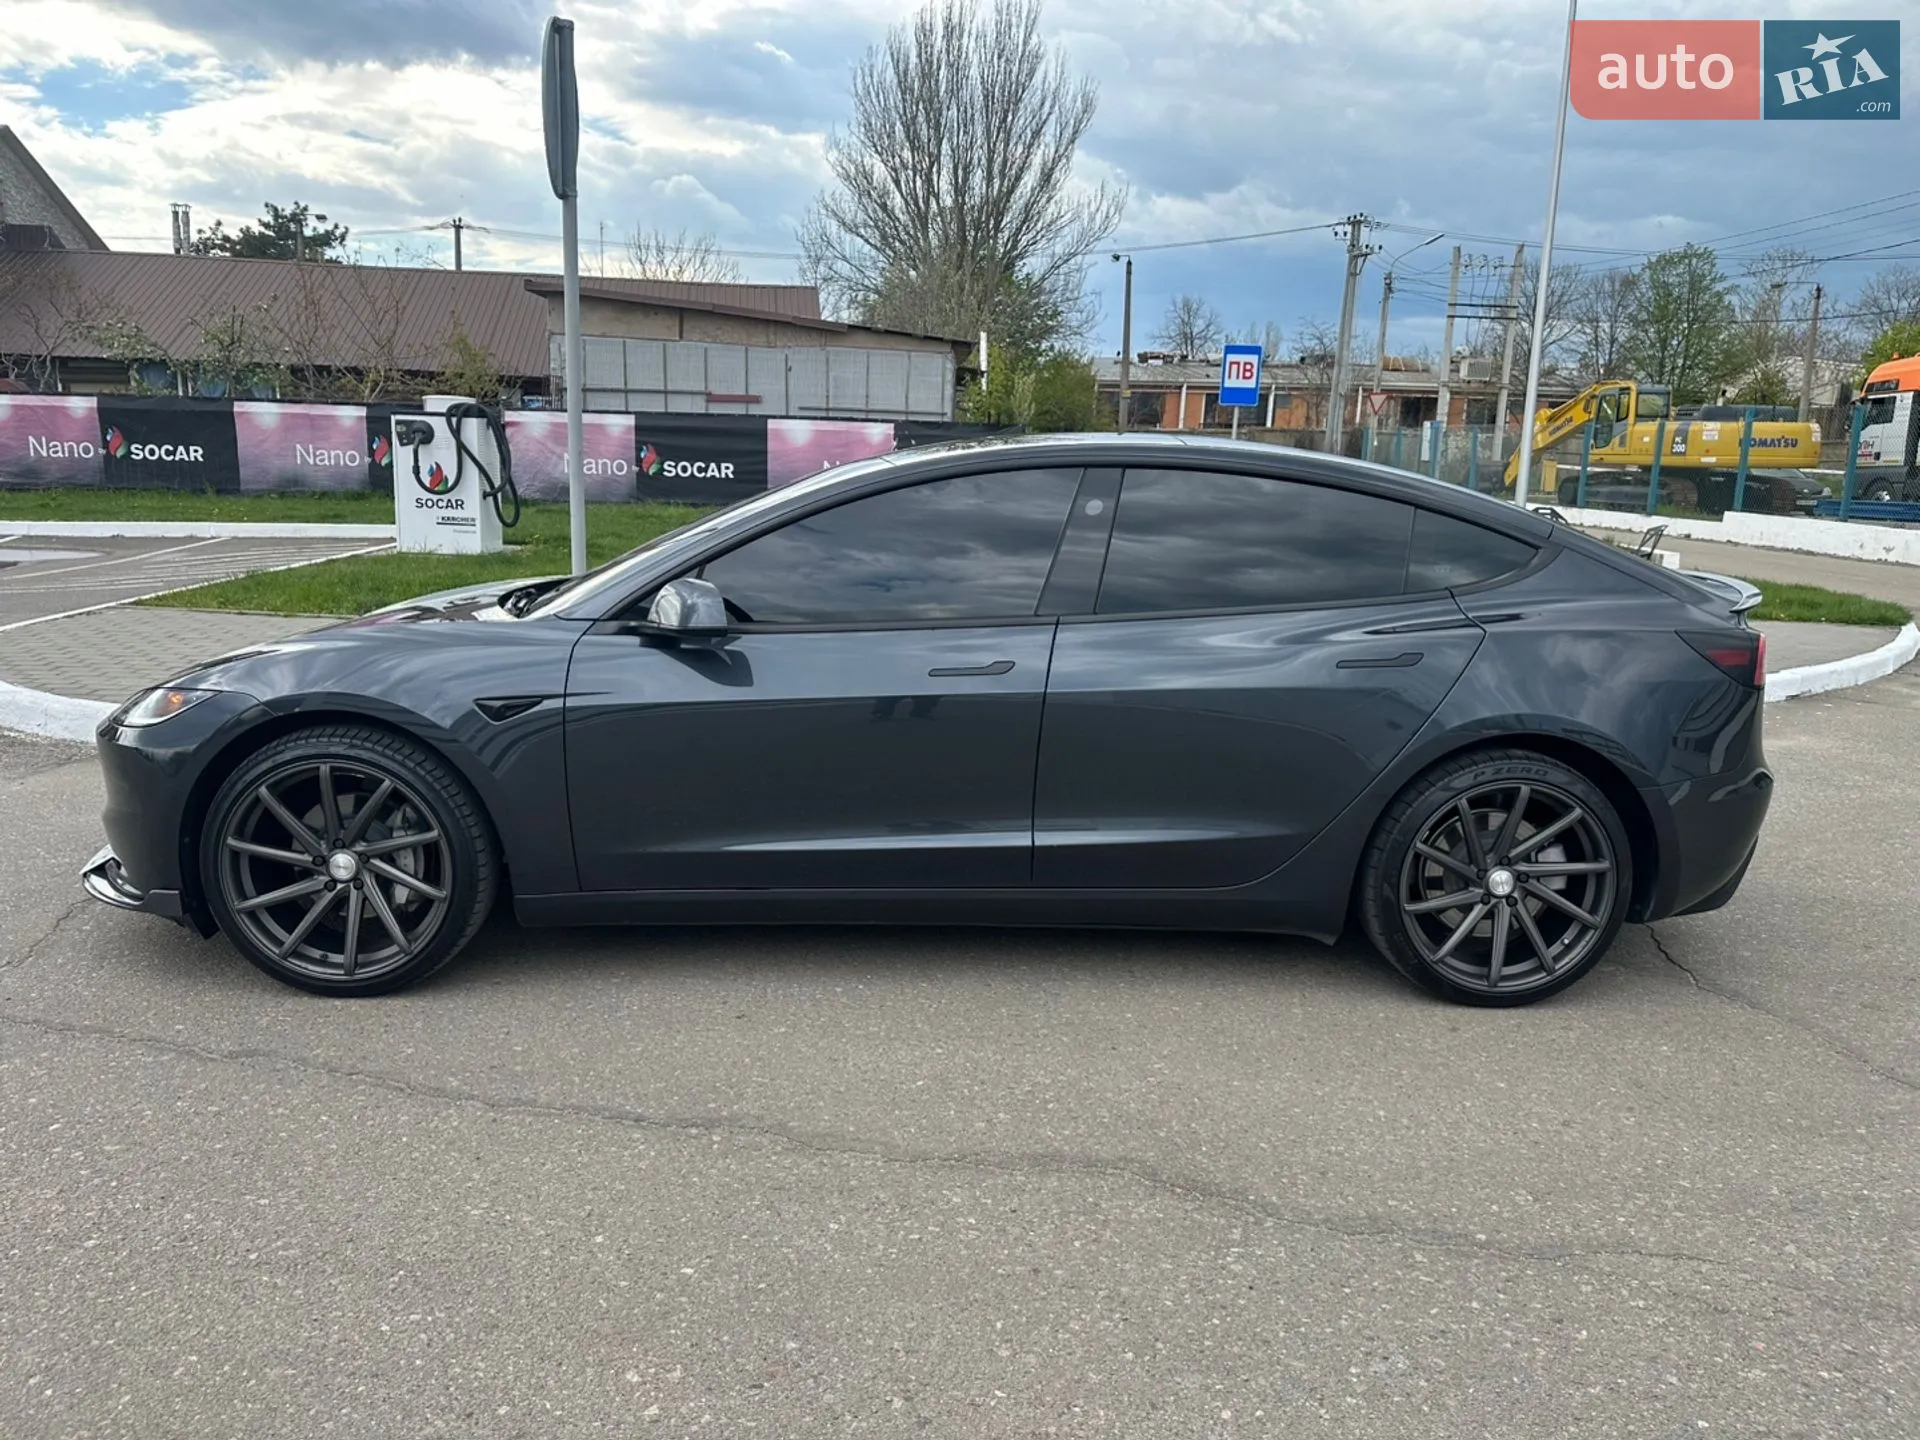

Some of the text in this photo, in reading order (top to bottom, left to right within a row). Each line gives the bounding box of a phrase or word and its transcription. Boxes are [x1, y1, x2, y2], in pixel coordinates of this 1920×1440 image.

[1228, 361, 1254, 380] ПВ
[28, 435, 204, 462] Nano SOCAR
[1739, 434, 1799, 449] OMATSU
[295, 443, 360, 467] Nano
[662, 461, 735, 479] SOCAR
[415, 497, 465, 511] SOCAR
